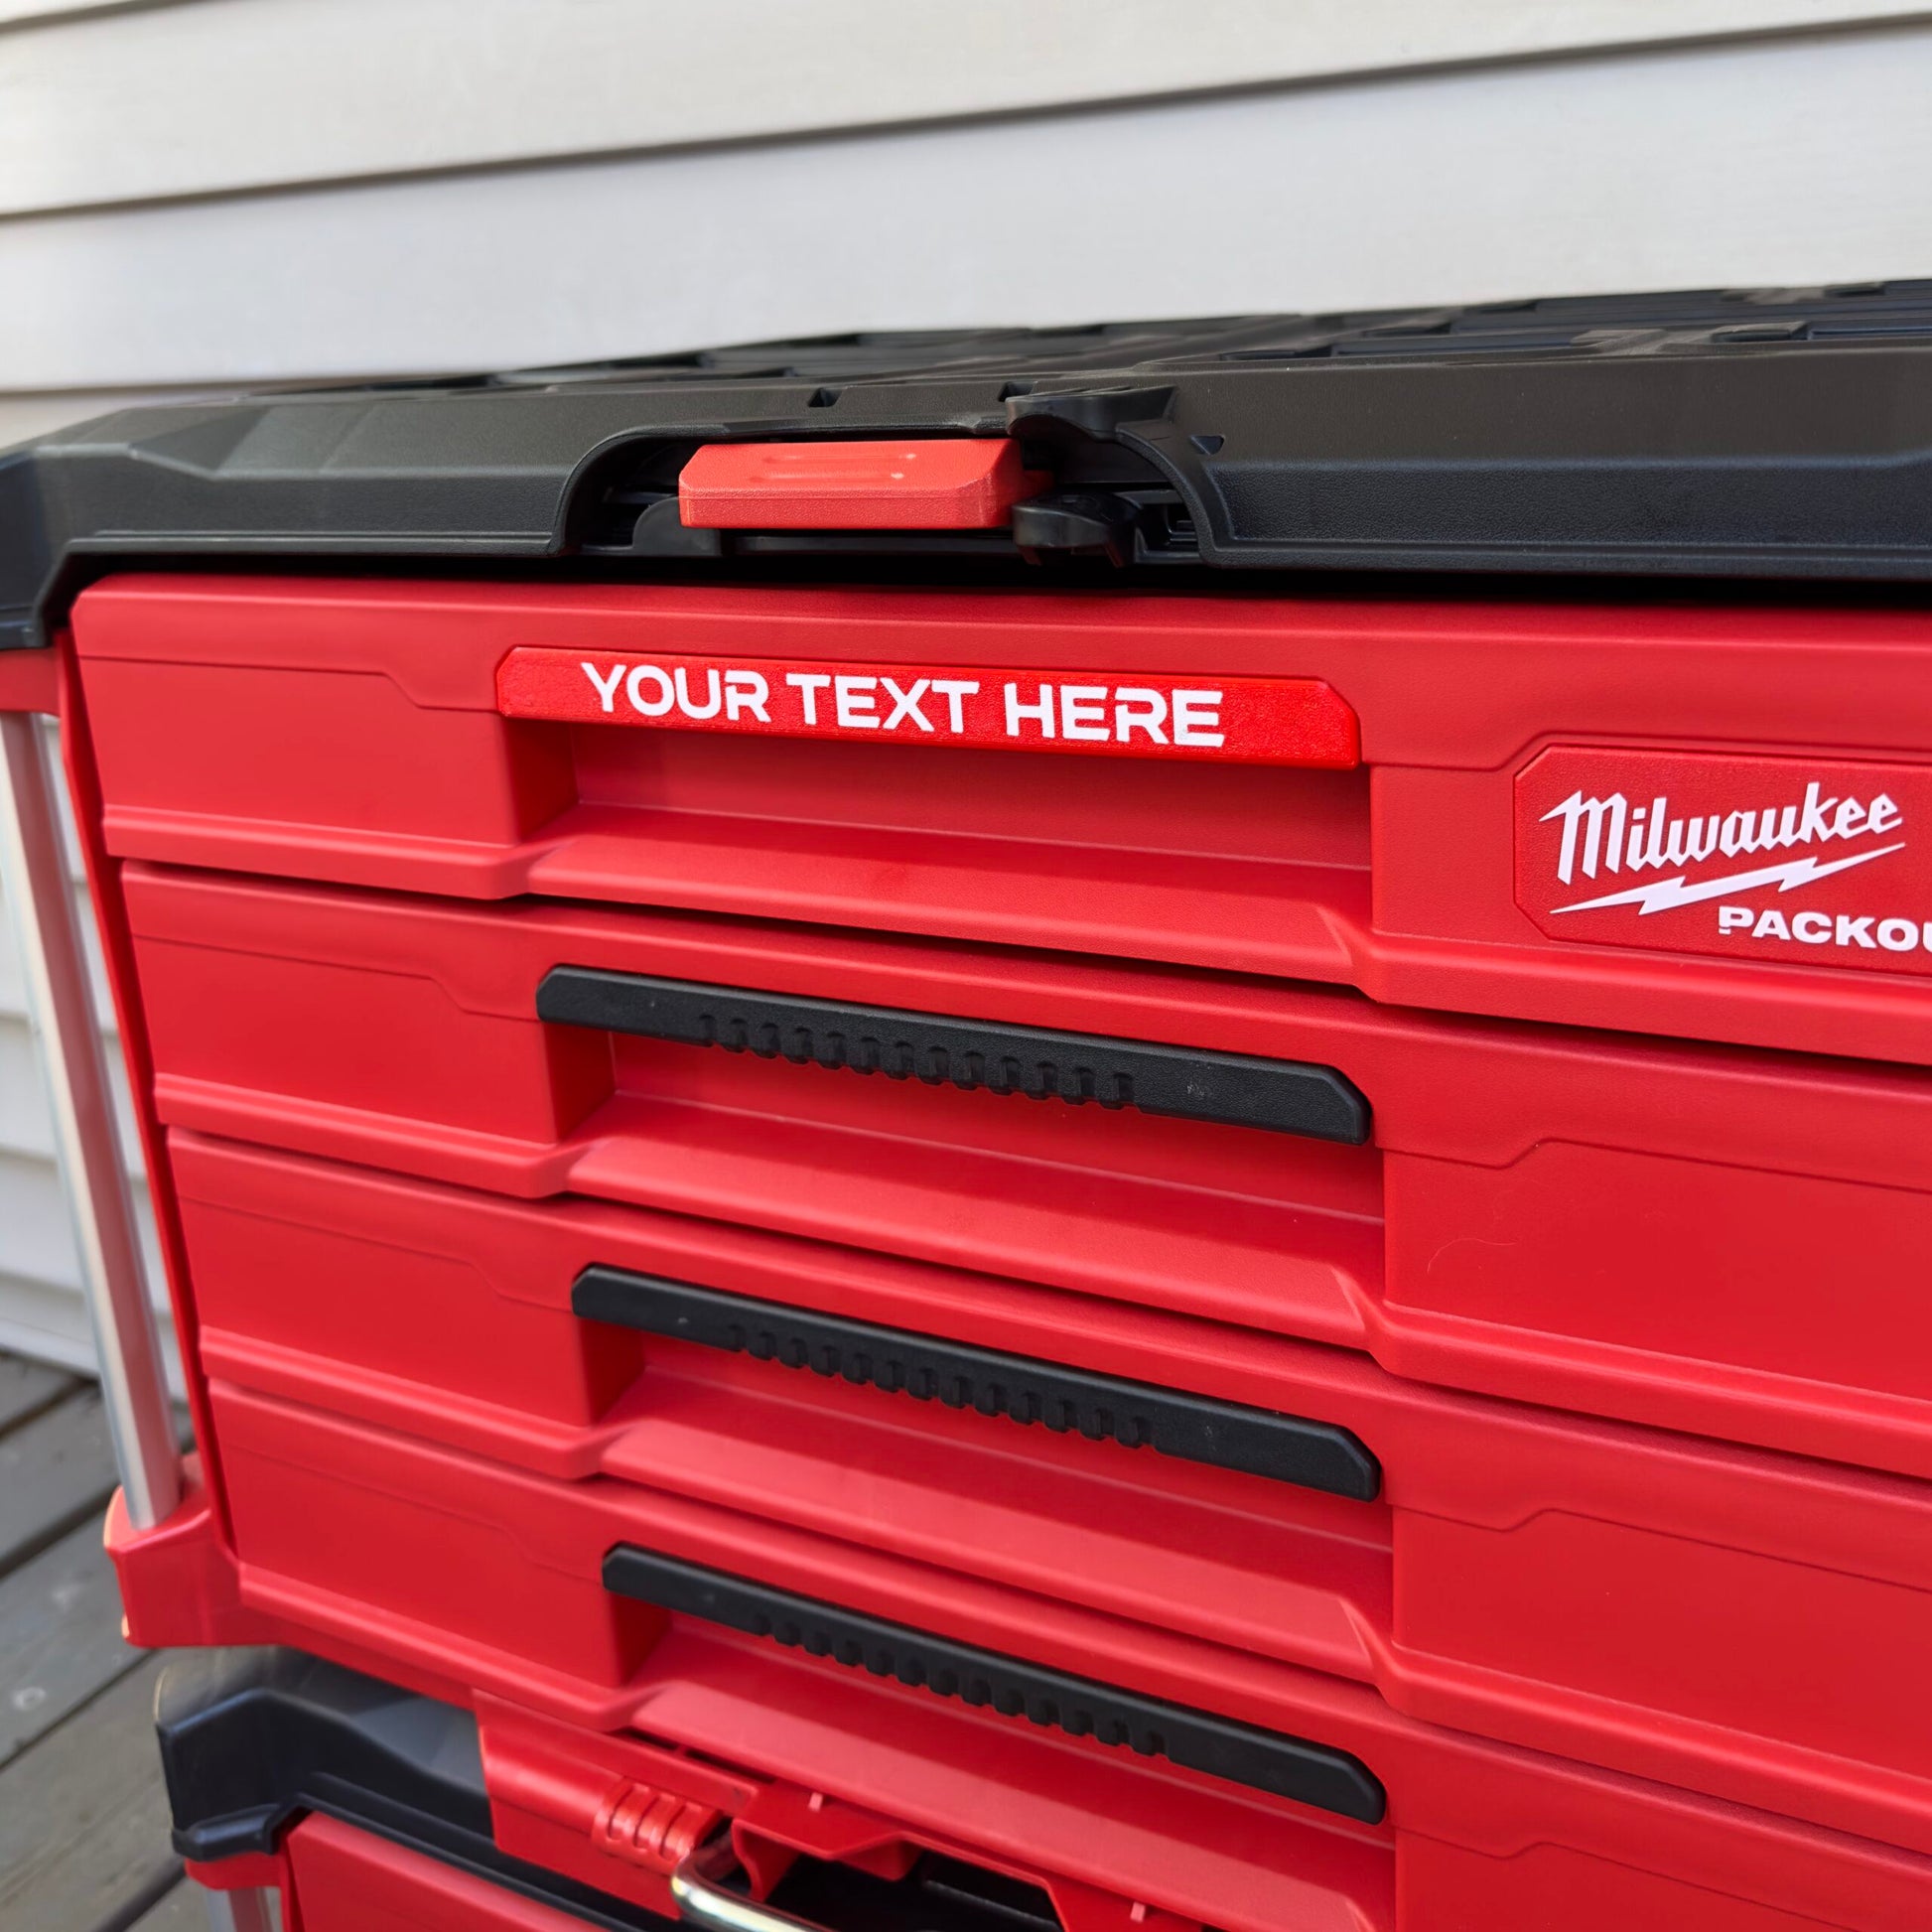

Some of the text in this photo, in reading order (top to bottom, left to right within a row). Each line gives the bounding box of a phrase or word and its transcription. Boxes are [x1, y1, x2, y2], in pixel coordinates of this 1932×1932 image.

[580, 661, 1225, 748] YOUR TEXT HERE
[1539, 781, 1903, 886] Milwaukee
[1719, 905, 1932, 953] PACKO
